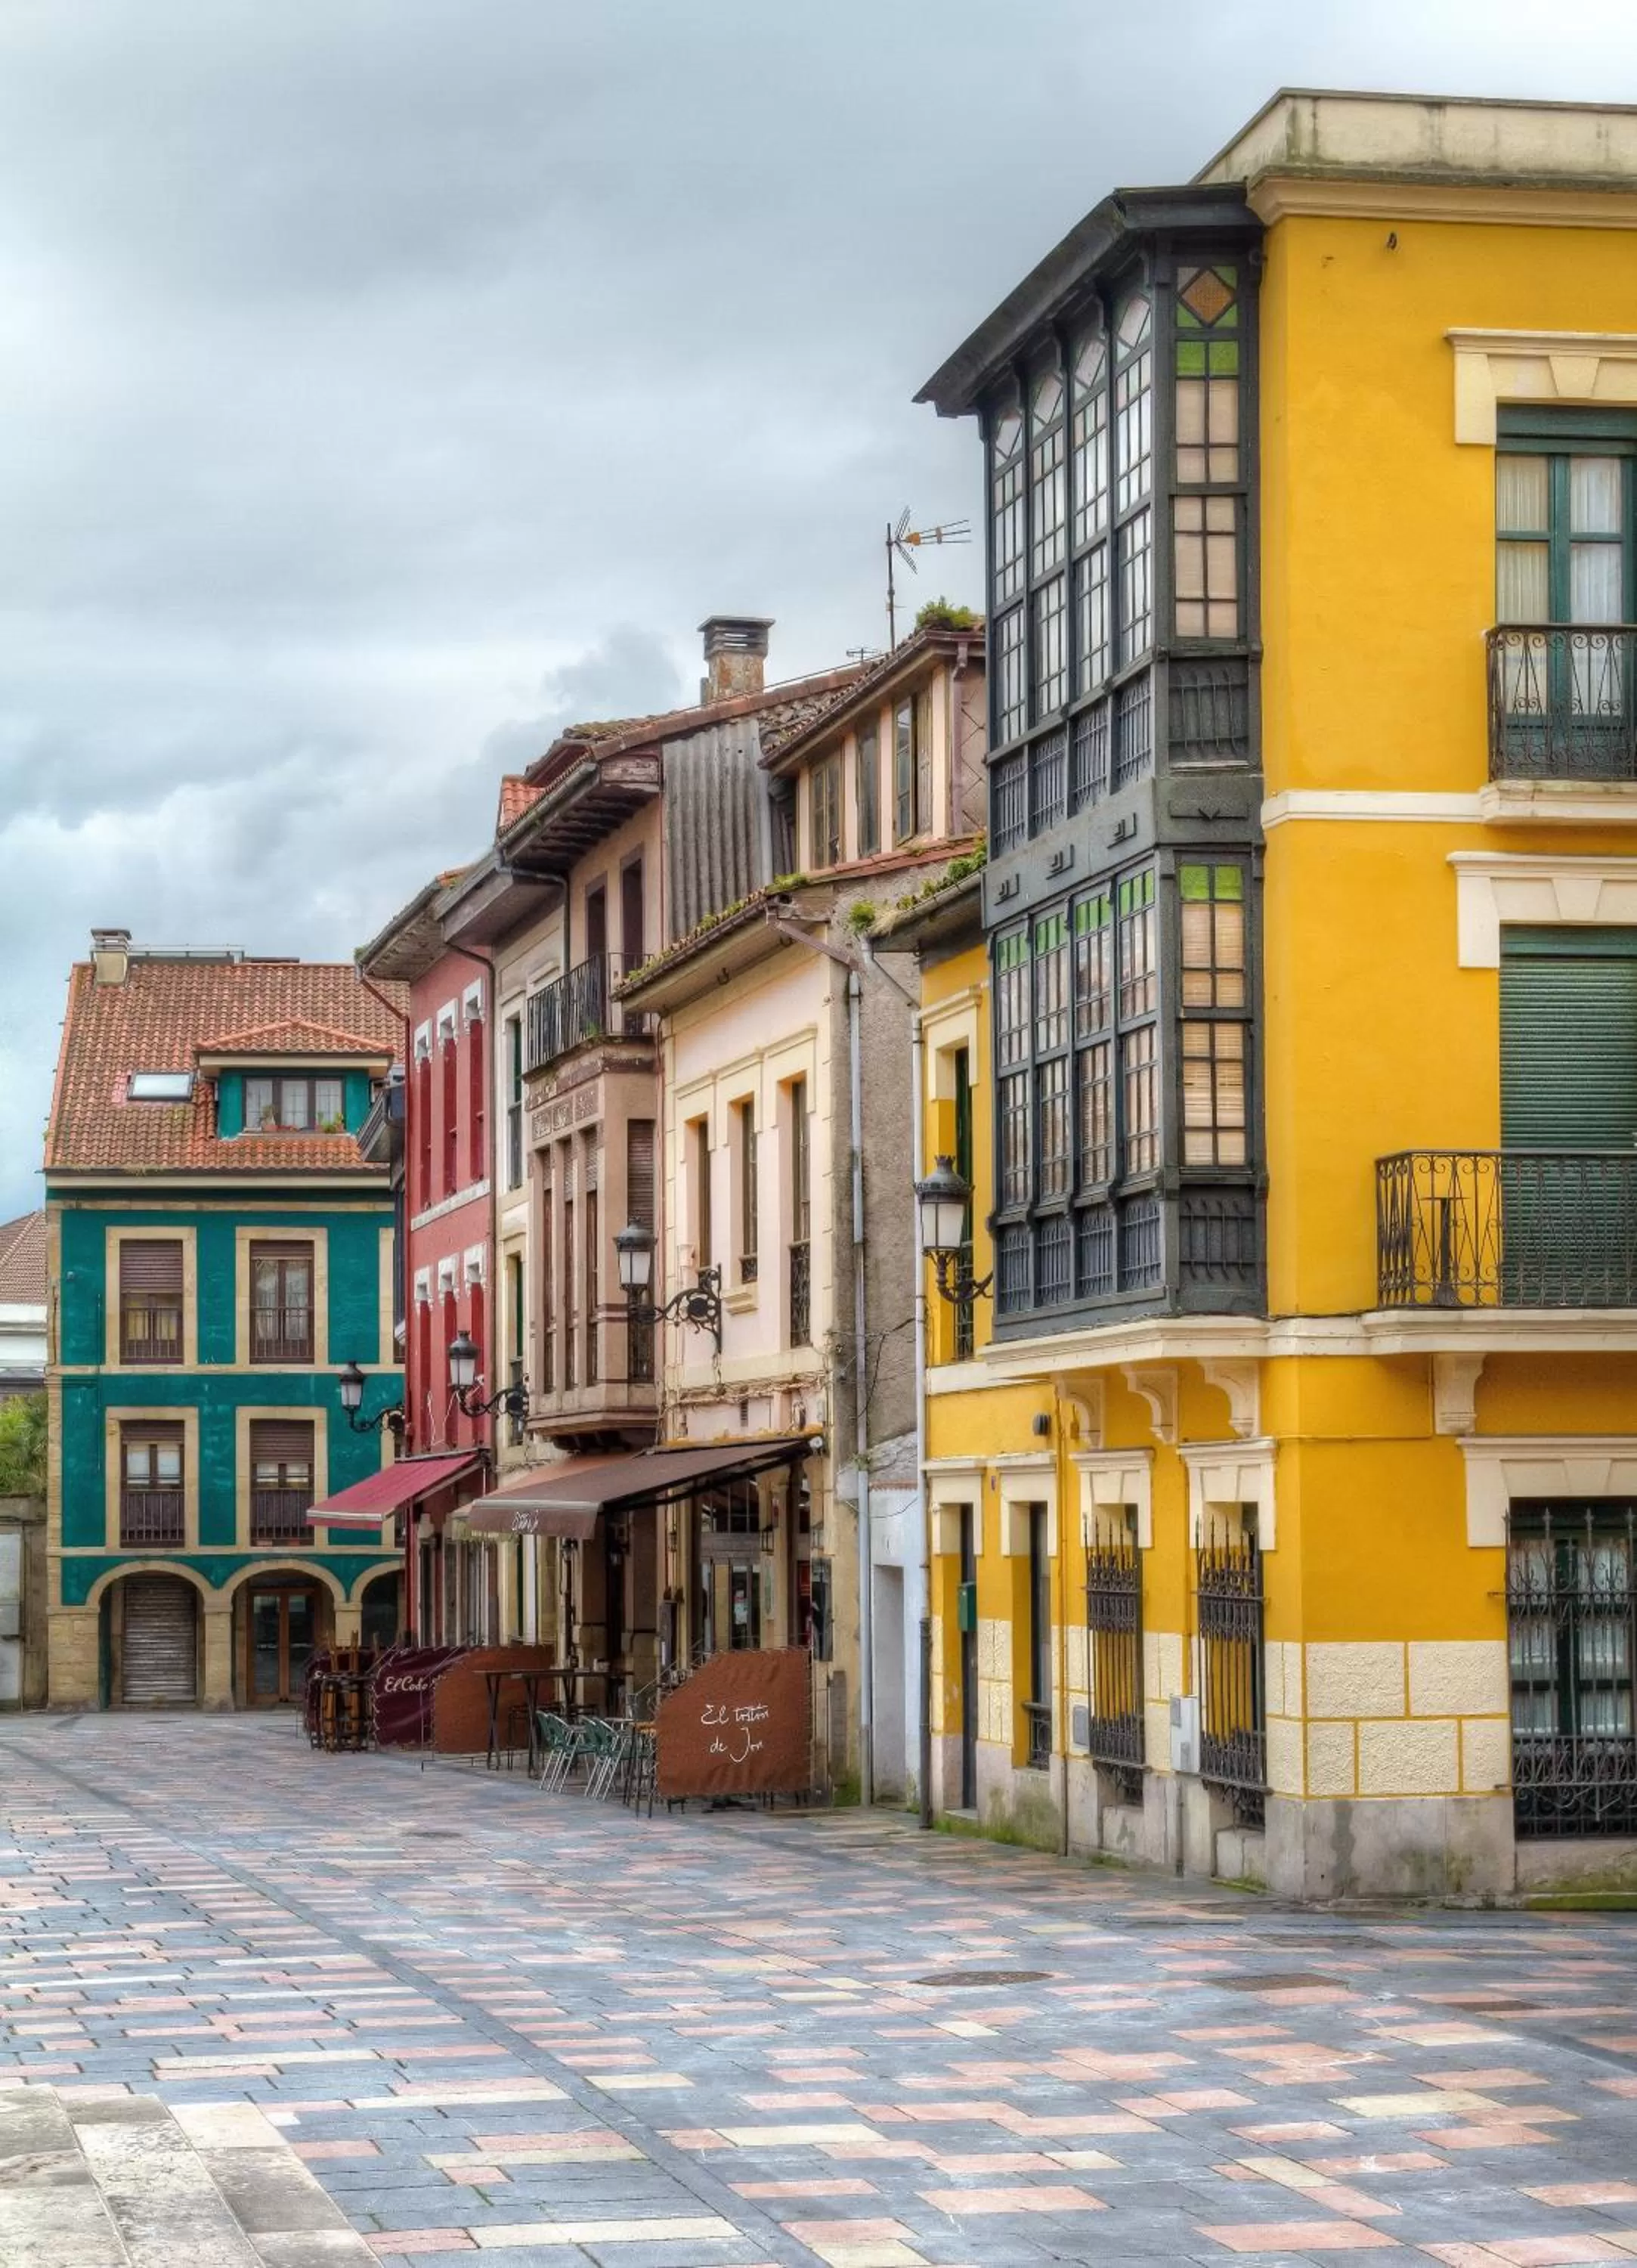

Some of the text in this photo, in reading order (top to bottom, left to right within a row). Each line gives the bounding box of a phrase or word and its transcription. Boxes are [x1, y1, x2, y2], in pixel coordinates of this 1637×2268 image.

[384, 1675, 402, 1693] El
[701, 1703, 729, 1724] El
[710, 1735, 728, 1753] de
